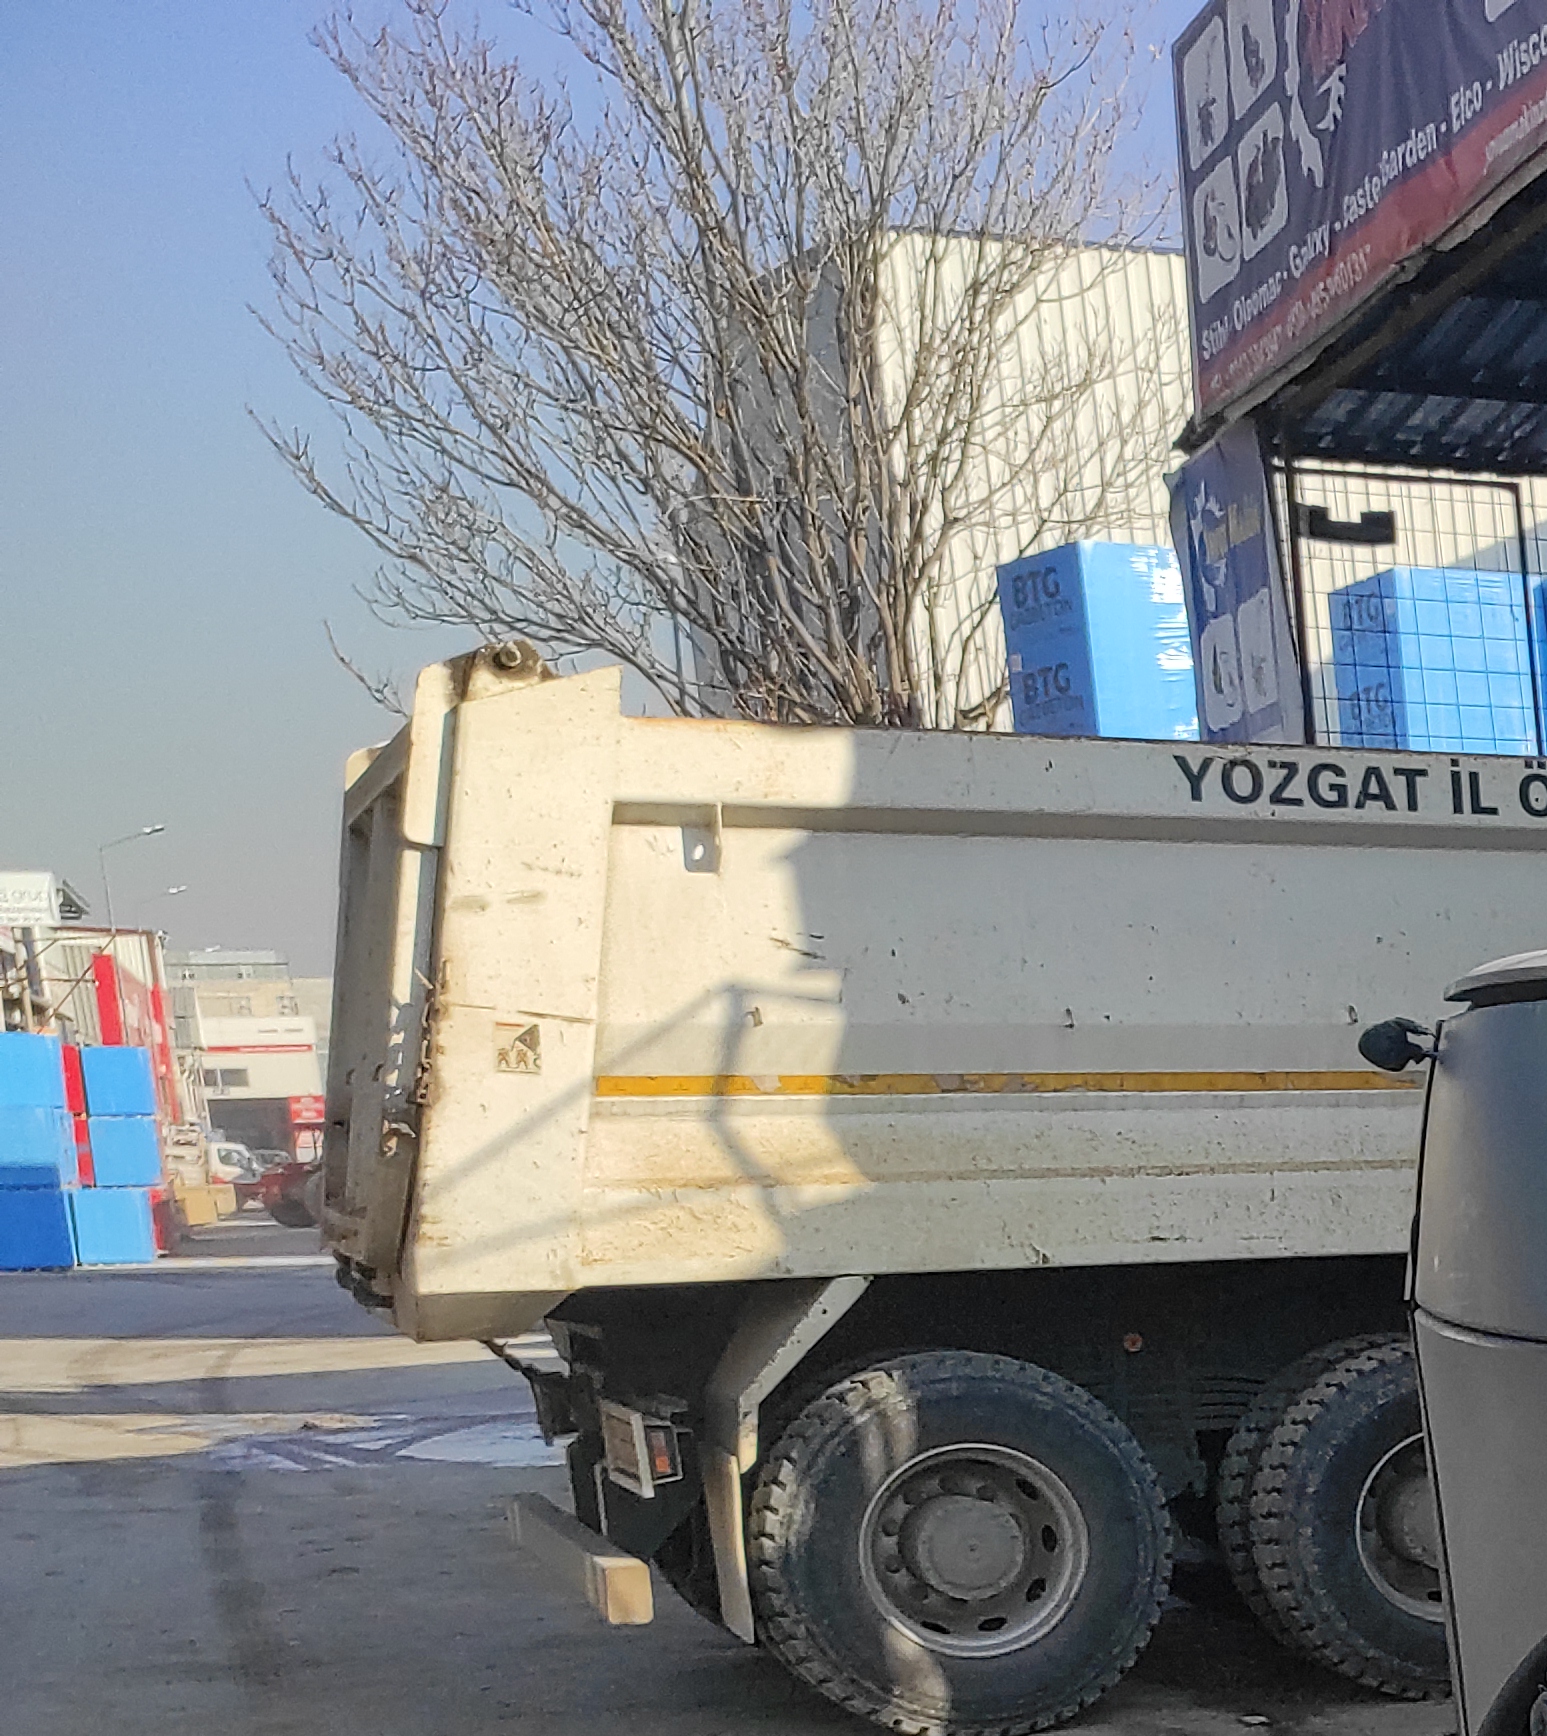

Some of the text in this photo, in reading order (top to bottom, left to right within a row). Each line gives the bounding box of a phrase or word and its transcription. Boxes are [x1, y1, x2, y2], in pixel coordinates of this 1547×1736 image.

[1011, 565, 1061, 609] BTG
[1022, 661, 1072, 706] BTG
[1172, 754, 1428, 812] YOZGAT
[1450, 758, 1499, 816] İL
